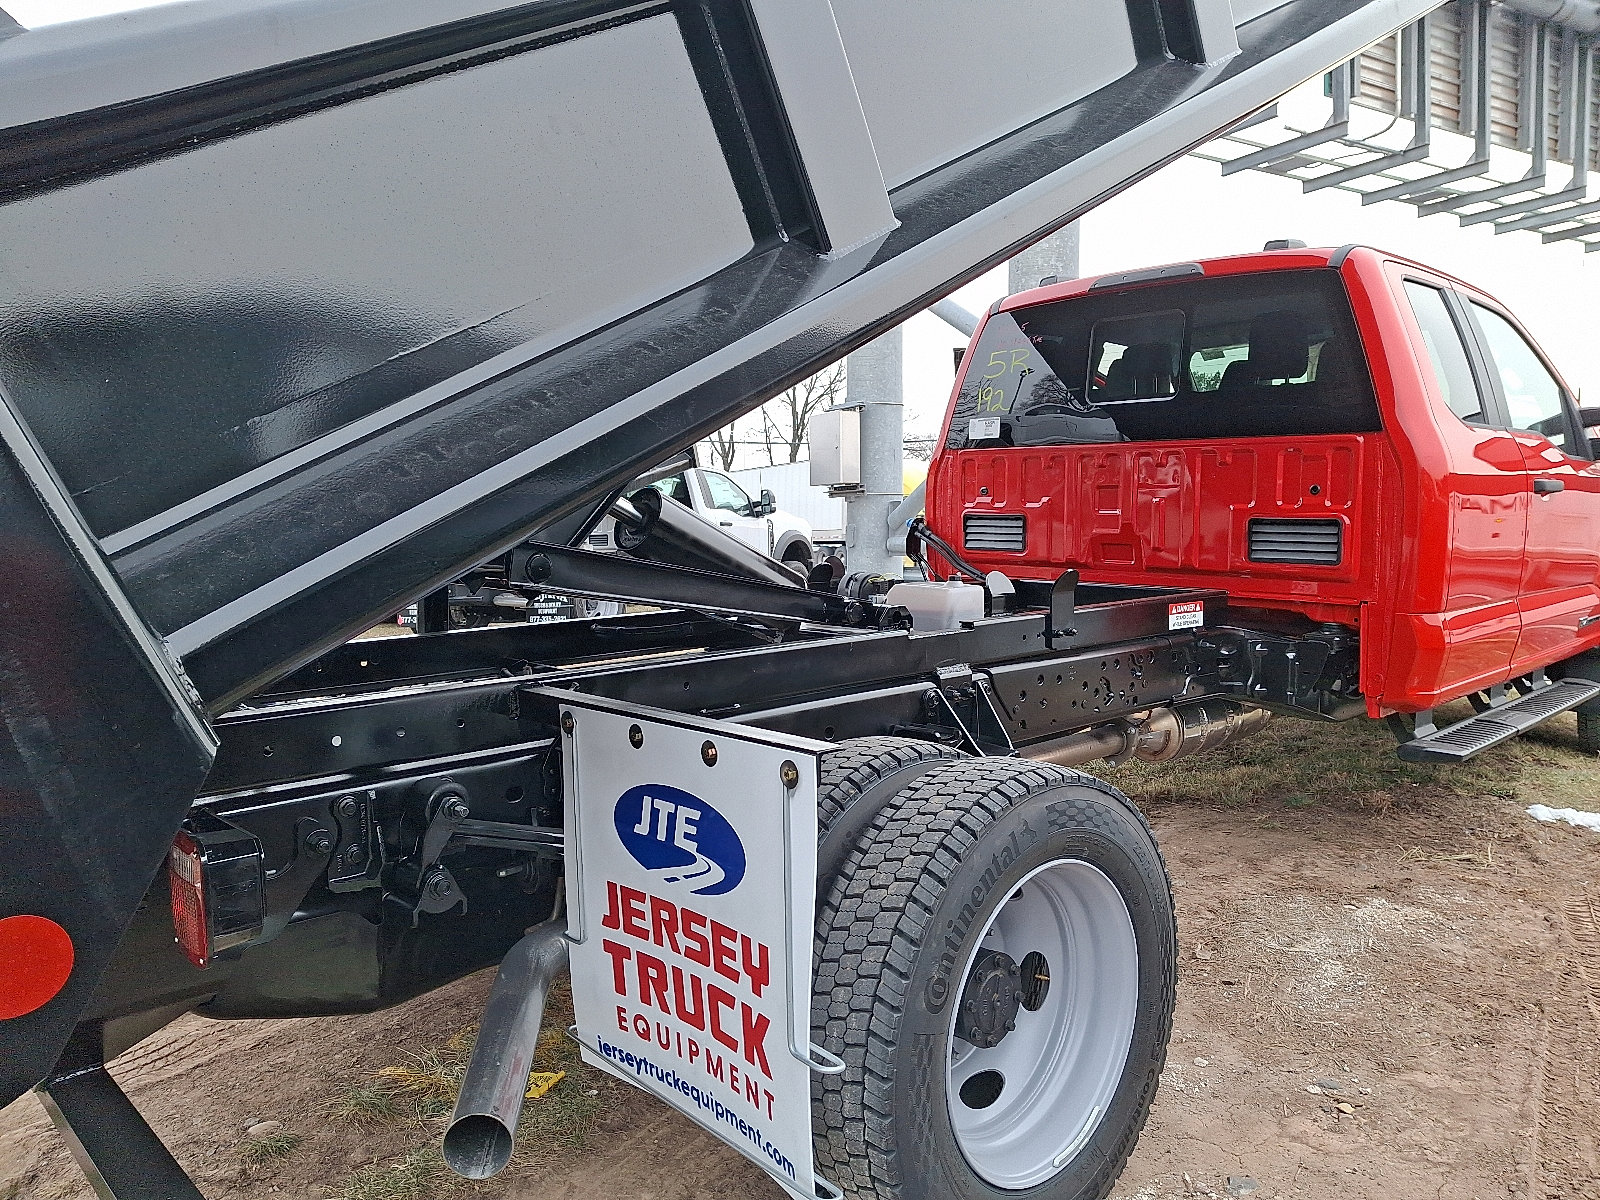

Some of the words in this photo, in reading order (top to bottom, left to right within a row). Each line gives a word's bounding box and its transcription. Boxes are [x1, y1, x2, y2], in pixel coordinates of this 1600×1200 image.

[977, 386, 1010, 413] 192
[1176, 603, 1196, 612] DANGER
[633, 795, 702, 852] JTE
[601, 880, 771, 999] JERSEY
[923, 829, 1022, 1017] Continental
[602, 938, 774, 1082] TRUCK
[616, 1005, 775, 1122] EQUIPMENT
[597, 1034, 797, 1182] jerseytruckequipment.com
